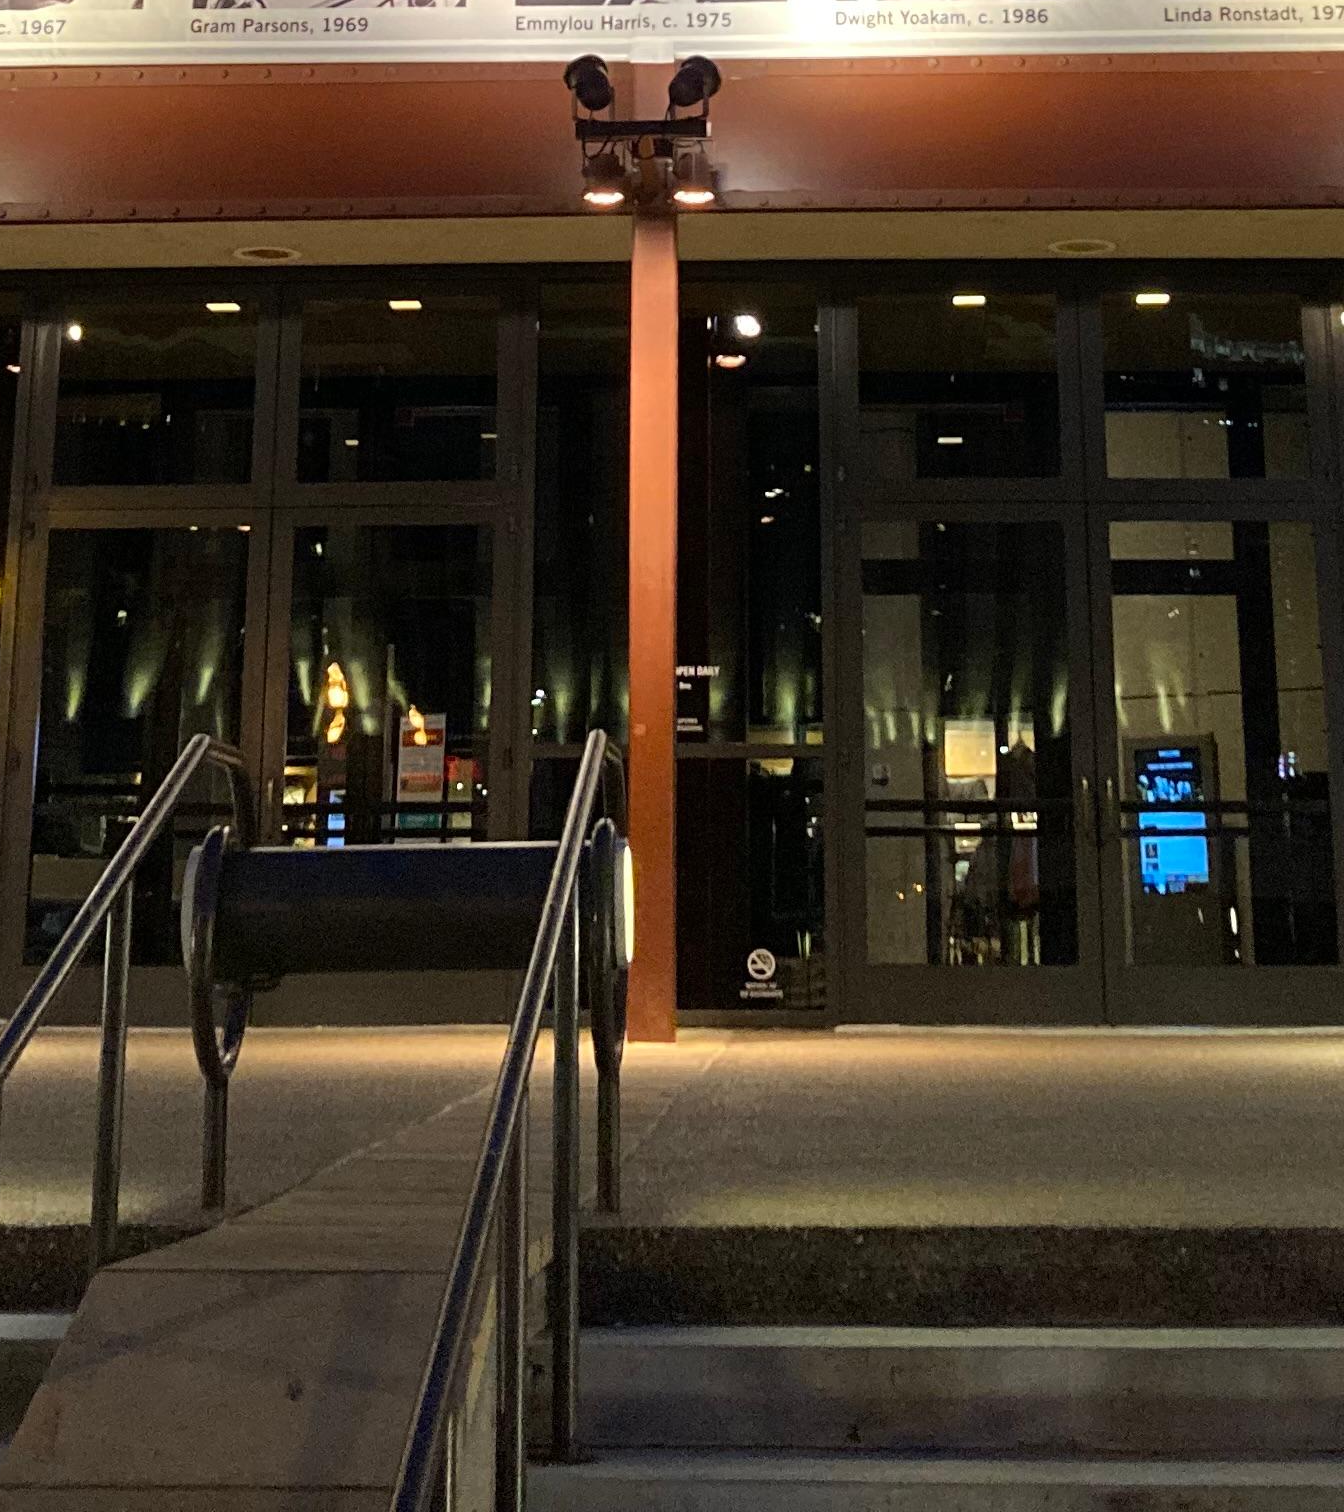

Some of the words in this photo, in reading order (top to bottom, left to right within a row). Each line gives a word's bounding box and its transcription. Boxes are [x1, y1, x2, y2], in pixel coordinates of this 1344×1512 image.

[515, 16, 593, 34] Emmylou
[601, 14, 656, 31] Harris,
[662, 17, 678, 28] c.
[686, 12, 732, 28] 1975
[835, 10, 894, 29] Dwight
[900, 9, 971, 27] Yoakam,
[978, 12, 994, 25] c.
[1002, 8, 1048, 24] 1986
[1164, 6, 1212, 23] Linda
[1220, 5, 1303, 24] Ronstadt,
[20, 19, 67, 35] 1967
[190, 18, 235, 33] Gram
[243, 18, 314, 35] Parsons,
[323, 17, 369, 32] 1969
